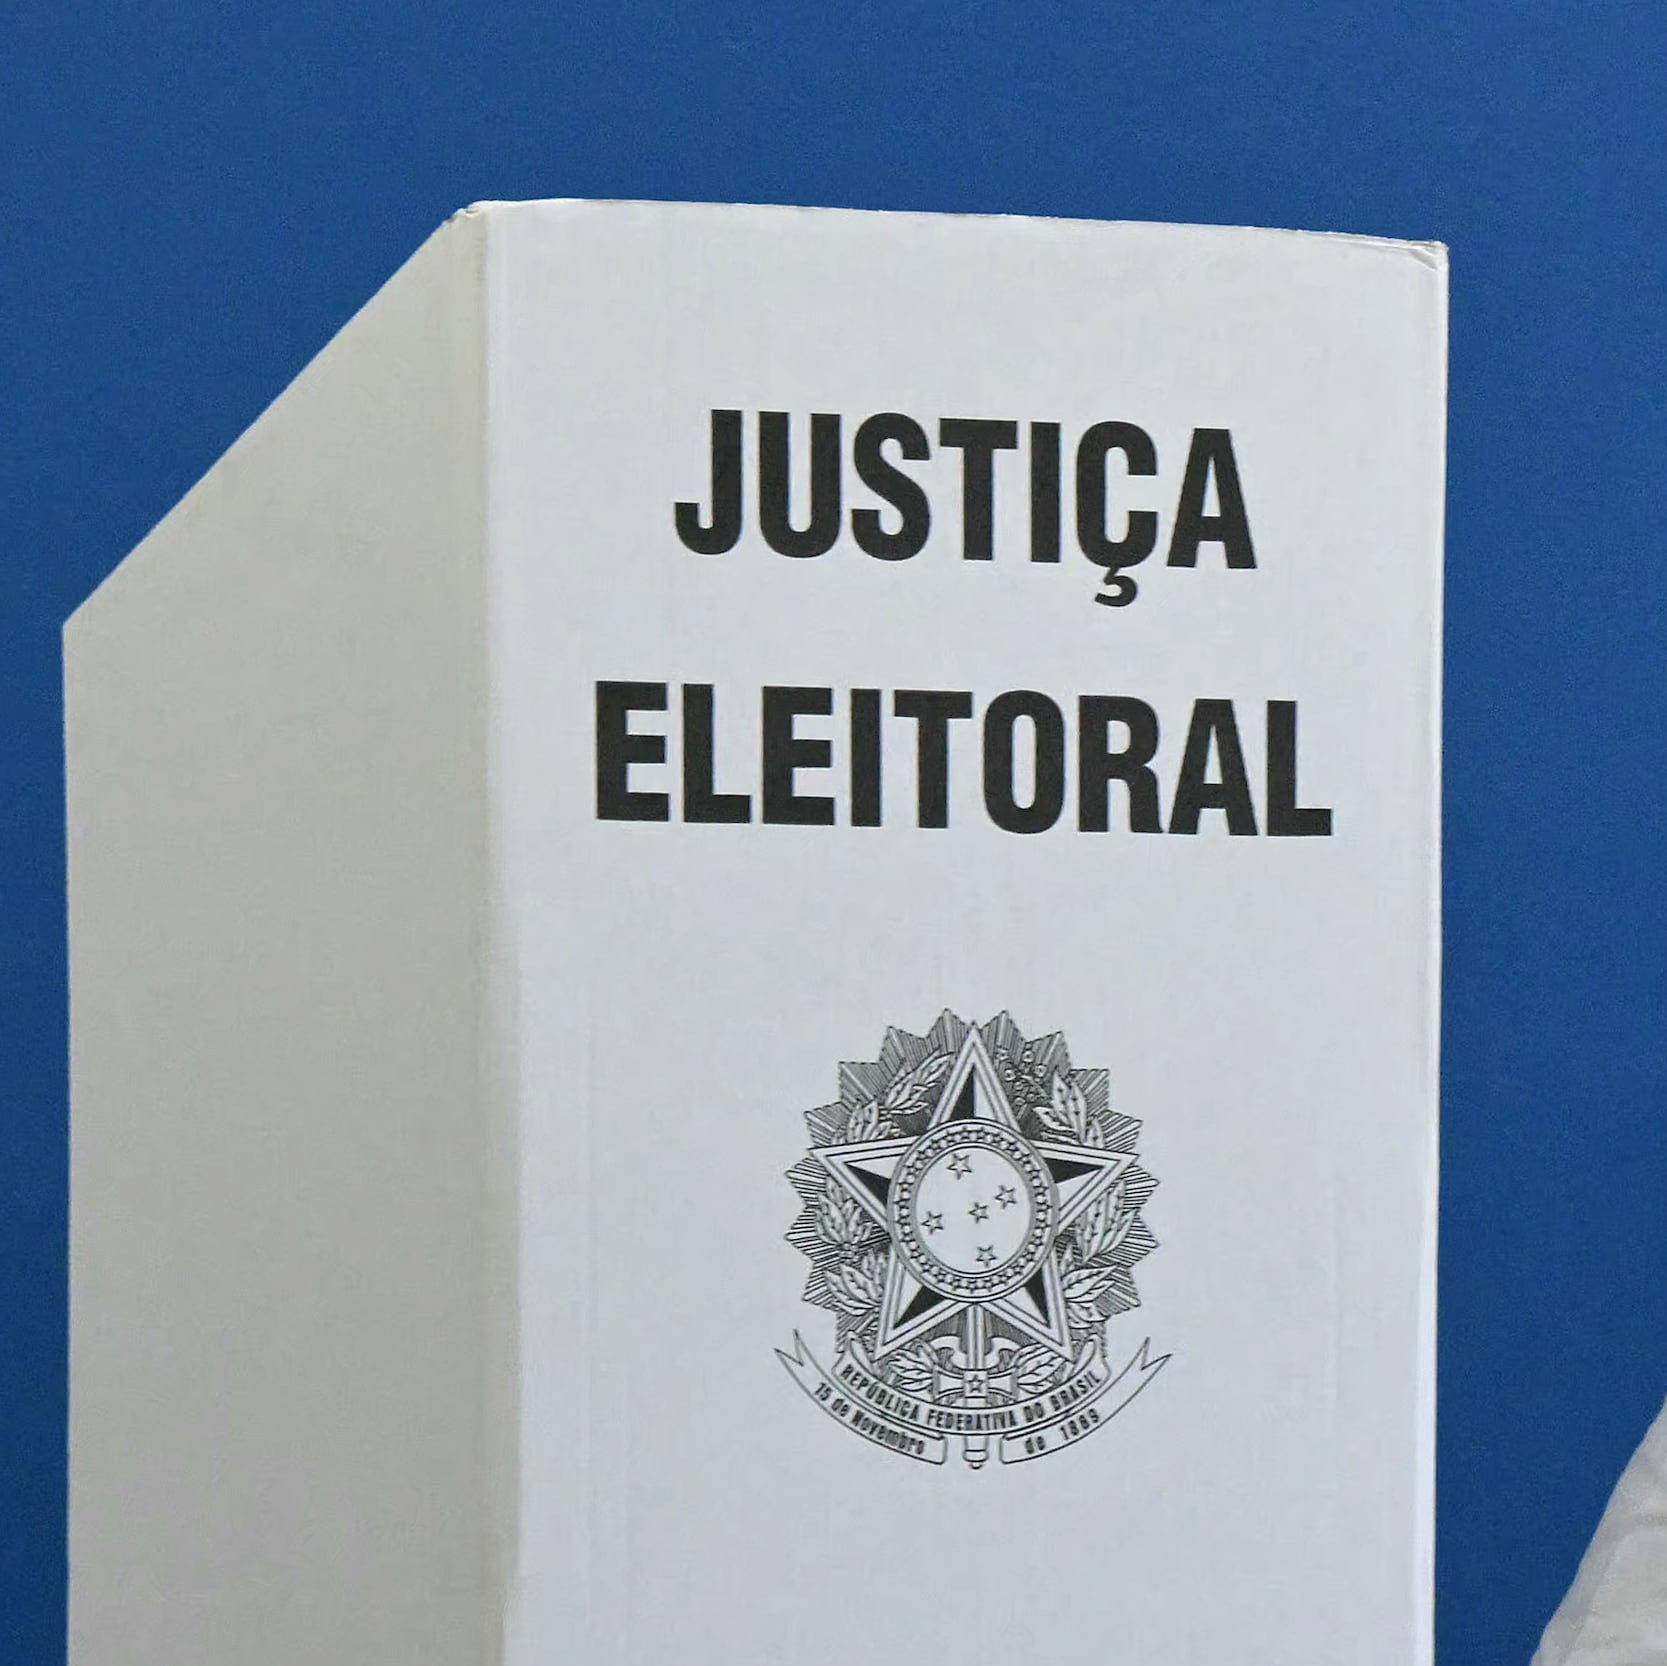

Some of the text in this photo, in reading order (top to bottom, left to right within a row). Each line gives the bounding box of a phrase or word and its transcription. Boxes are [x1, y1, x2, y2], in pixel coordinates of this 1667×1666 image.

[673, 408, 1258, 607] JUSTIÇA
[595, 679, 1334, 838] ELEITORAL
[814, 1382, 832, 1401] 15
[1024, 1436, 1046, 1455] de
[1060, 1408, 1100, 1440] 1889
[841, 1363, 1101, 1431] REPÚBLICA FEDERATIVA DO BRASIL
